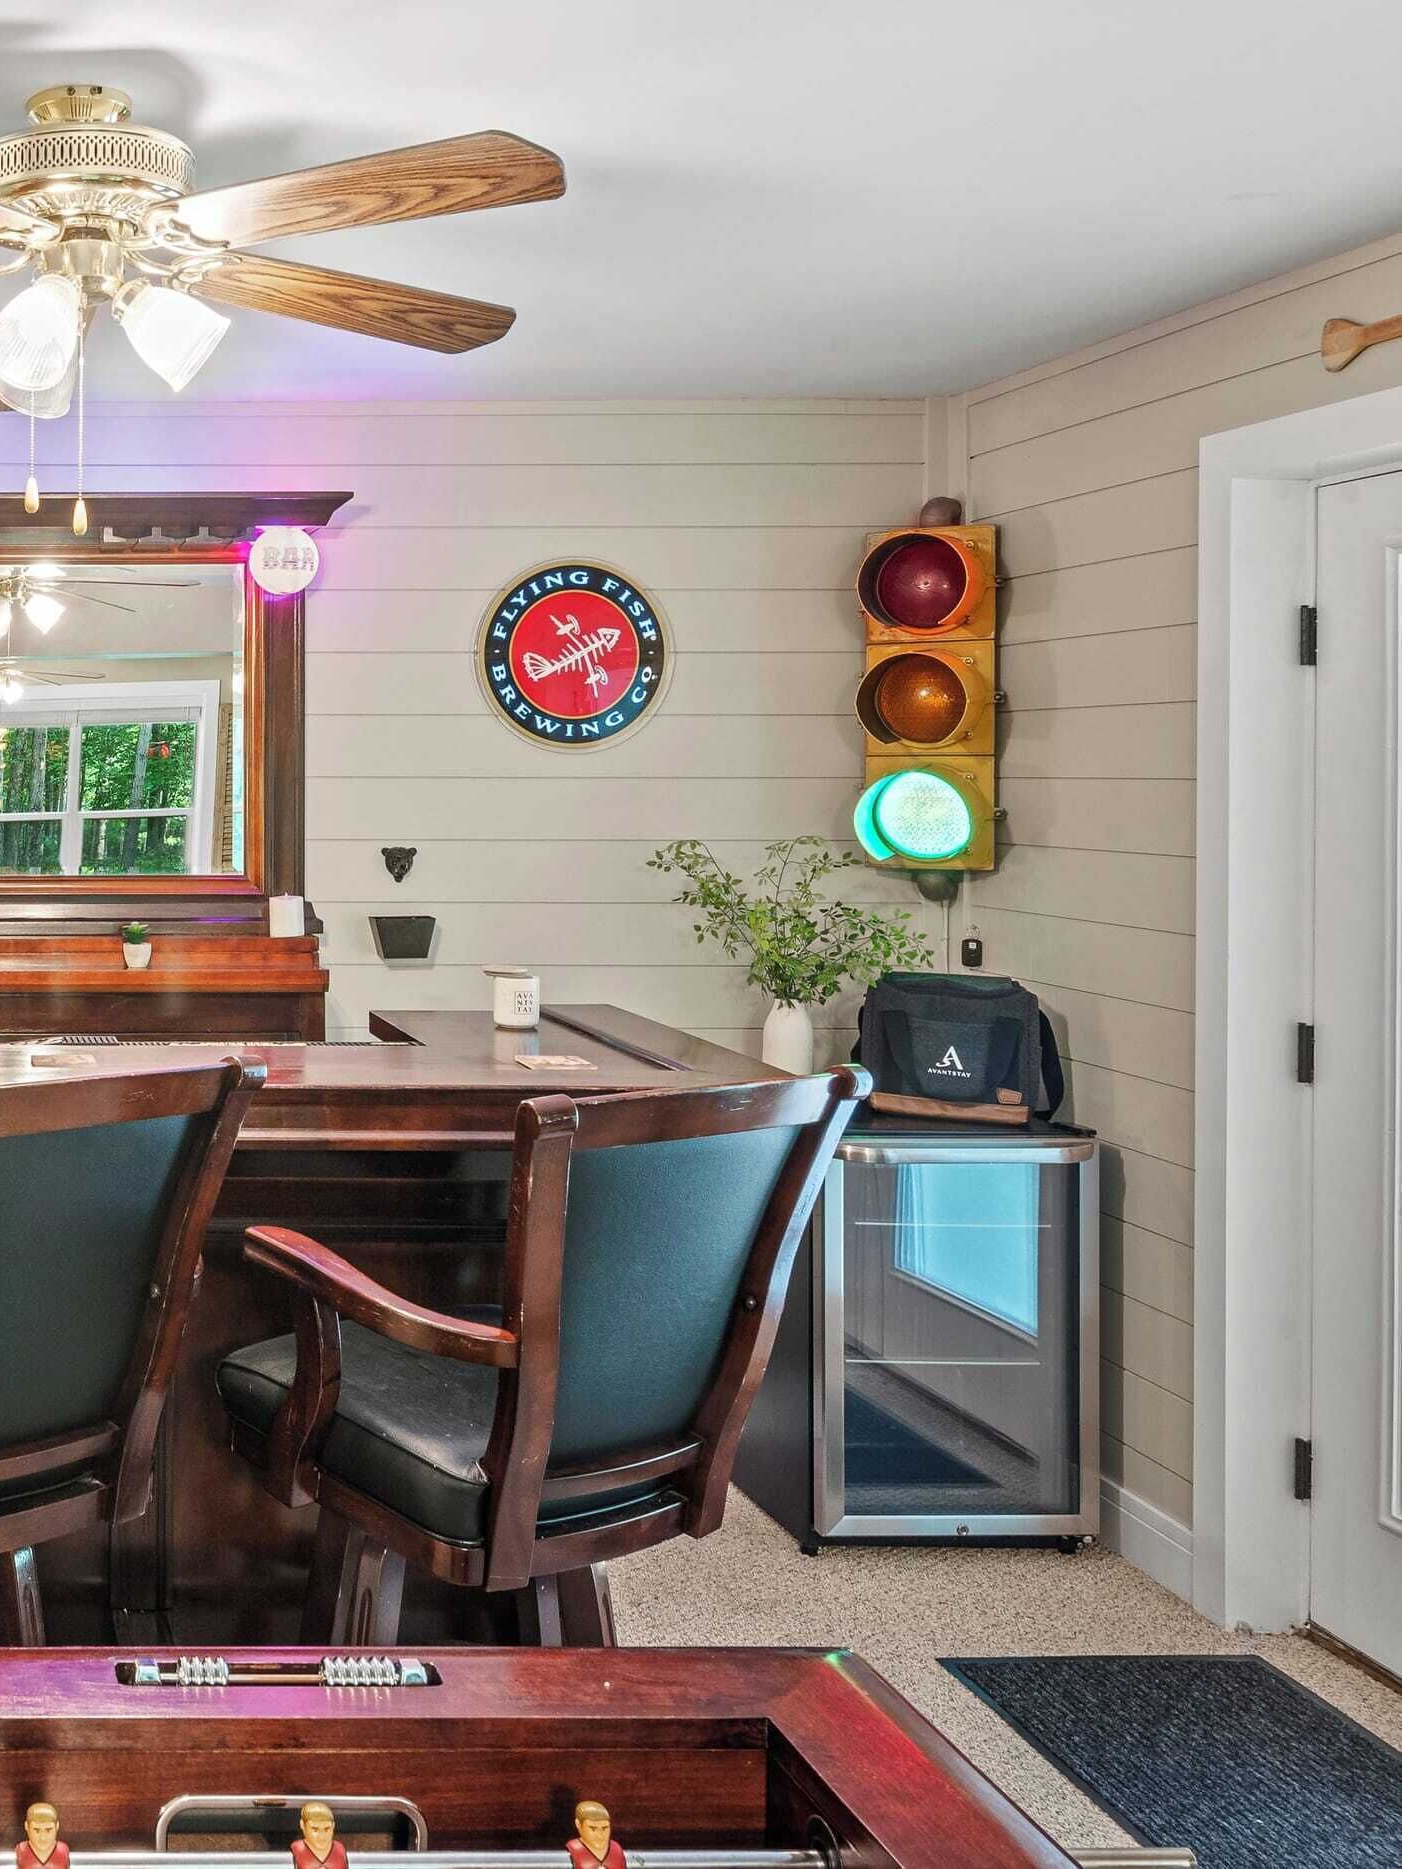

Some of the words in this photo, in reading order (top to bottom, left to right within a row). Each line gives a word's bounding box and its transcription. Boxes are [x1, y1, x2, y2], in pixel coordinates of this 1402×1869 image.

[493, 571, 589, 640] FLYING
[602, 578, 656, 639] FISH
[493, 664, 625, 737] BREWING
[927, 1067, 972, 1078] AVANTSTAY
